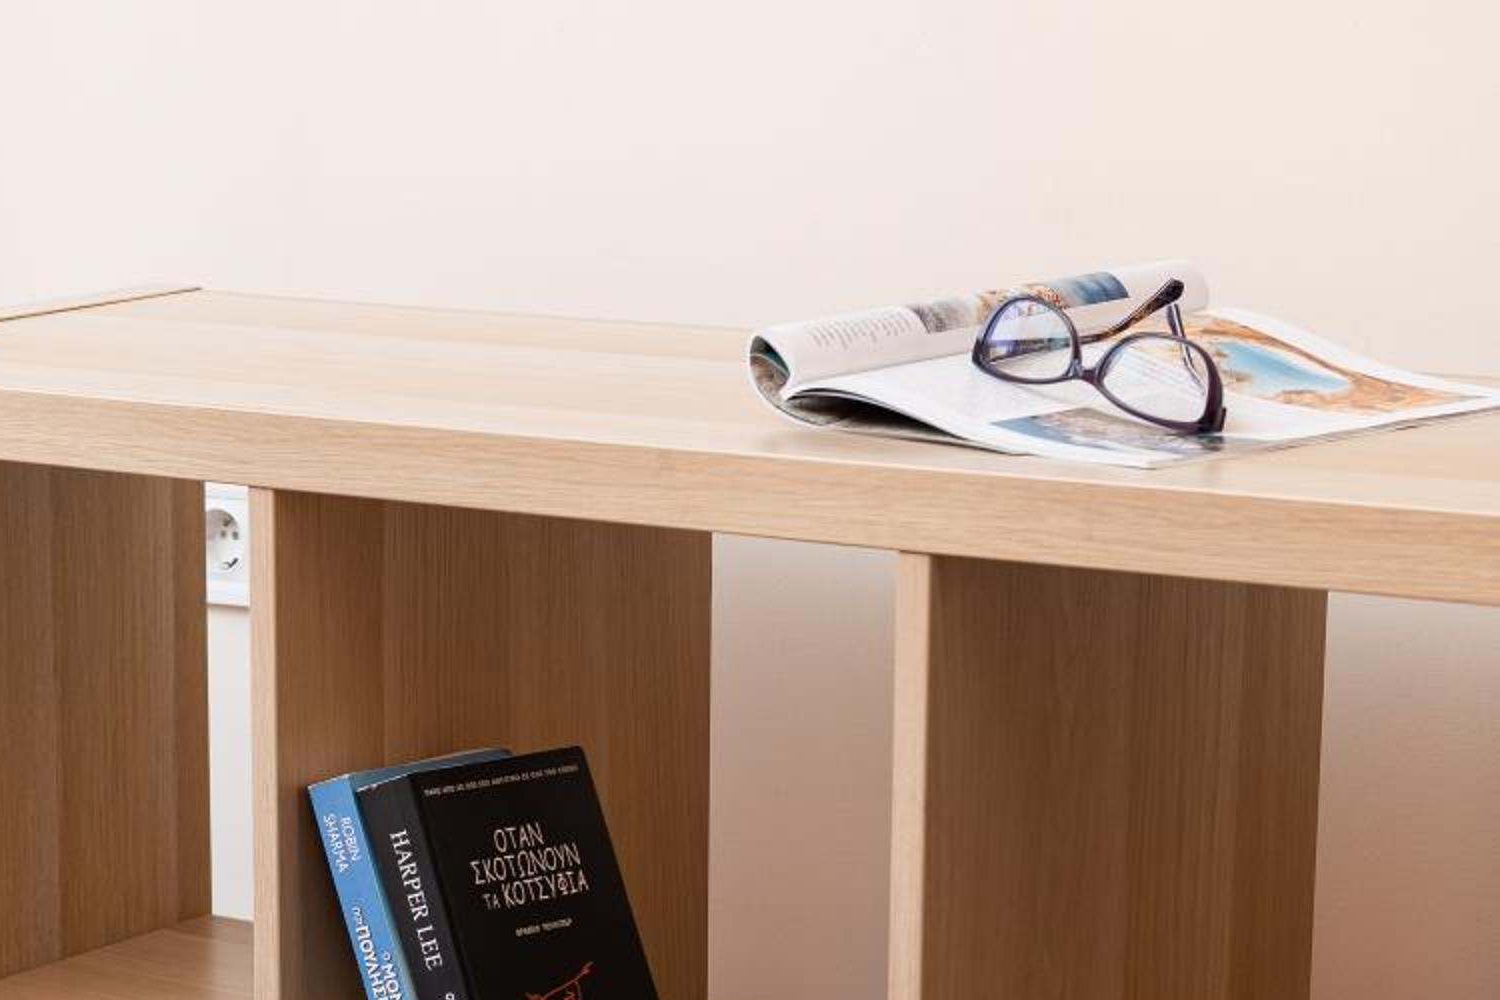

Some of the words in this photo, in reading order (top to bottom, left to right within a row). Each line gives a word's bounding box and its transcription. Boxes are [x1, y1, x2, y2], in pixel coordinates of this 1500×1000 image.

[323, 813, 349, 873] SHARMA
[340, 816, 361, 861] ROBIN
[493, 821, 545, 853] ΟΤΑΝ
[470, 841, 581, 885] ΣΚΟΤΩΝΟΥΝ
[389, 828, 430, 921] HARPER
[416, 924, 443, 971] LEE
[501, 869, 589, 909] ΚΟΤΣΥΦΙΑ
